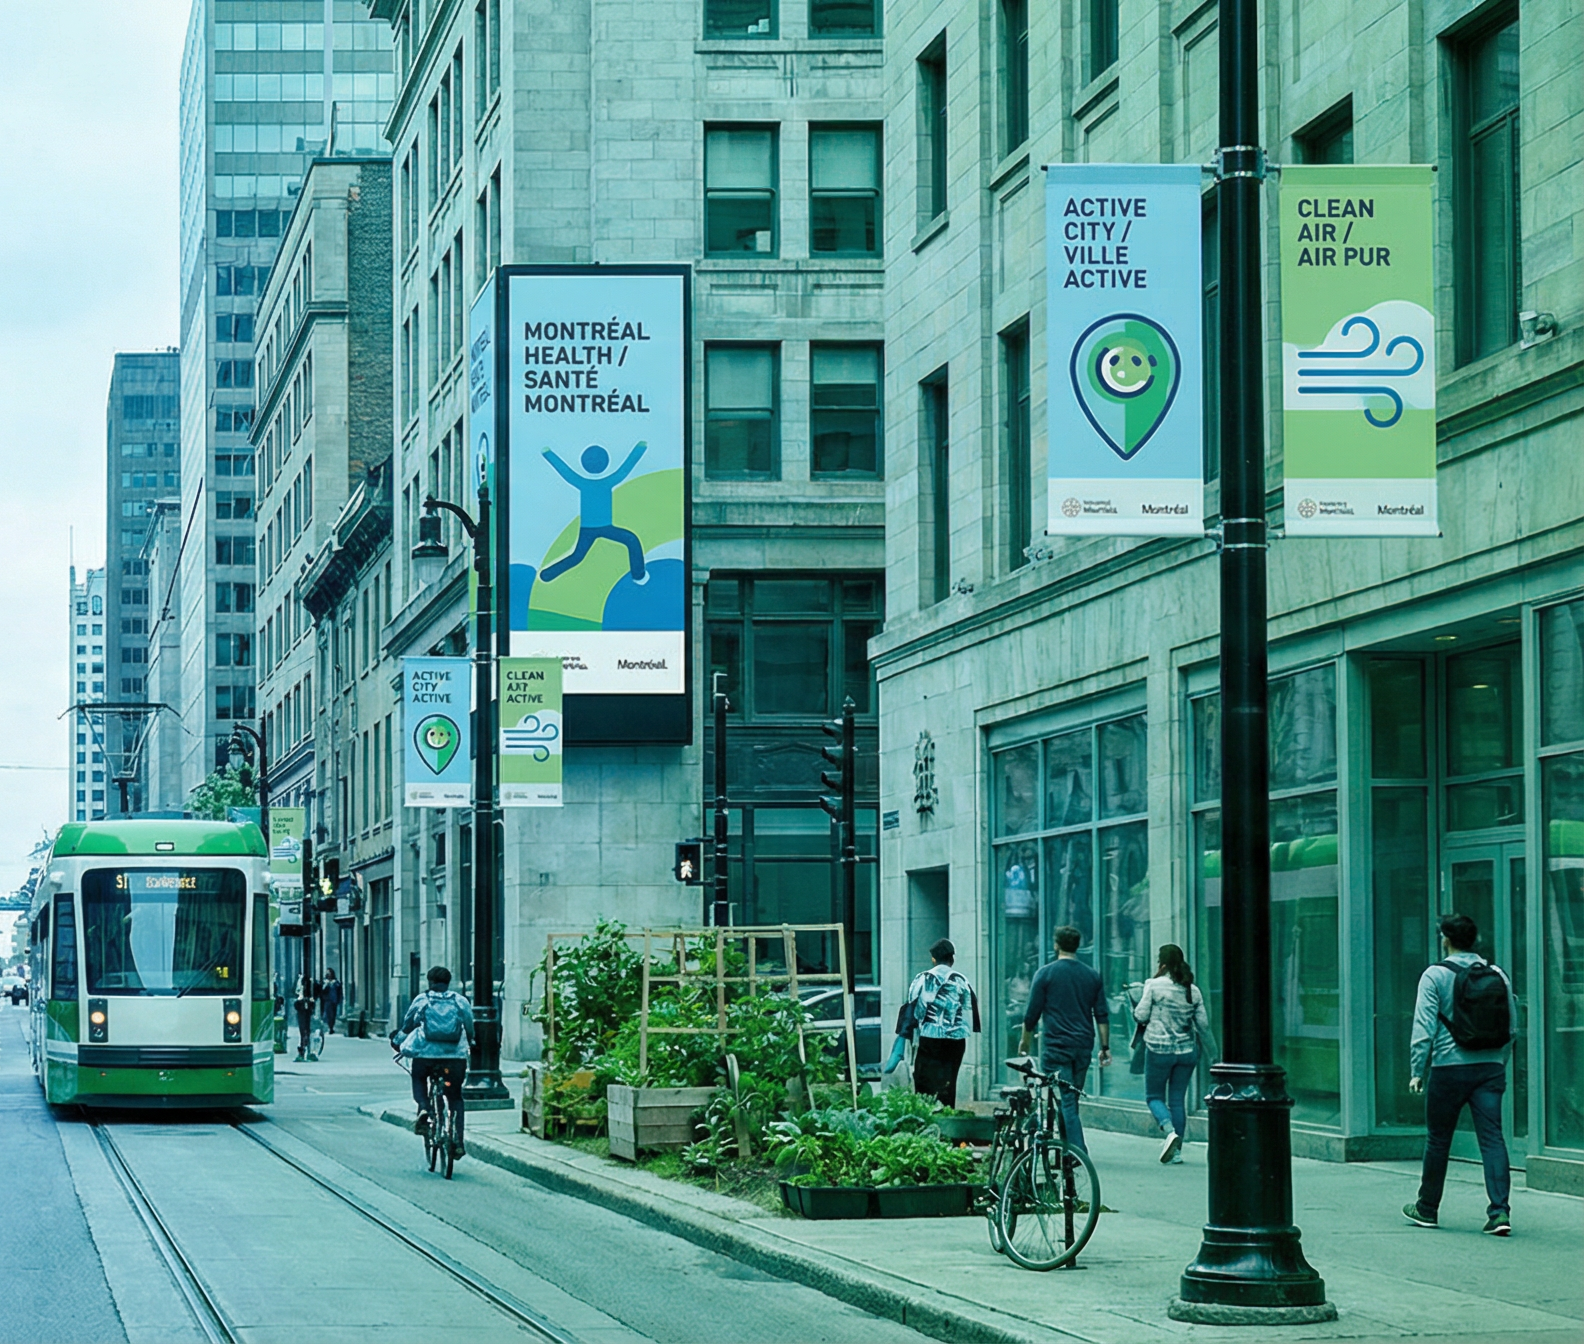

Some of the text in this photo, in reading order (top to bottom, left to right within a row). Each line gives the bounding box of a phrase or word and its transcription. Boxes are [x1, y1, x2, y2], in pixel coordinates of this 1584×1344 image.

[1063, 197, 1147, 218] ACTIVE
[1297, 198, 1374, 219] CLEAN
[1064, 219, 1133, 244] CITY /
[1297, 220, 1354, 244] AIR /
[1063, 245, 1129, 265] VILLE
[1297, 246, 1391, 267] AIR PUR
[1063, 268, 1147, 289] ACTIVE
[524, 316, 651, 341] MONTRÉAL
[524, 344, 629, 367] HEALTH /
[524, 366, 599, 390] SANTÉ
[524, 388, 651, 414] MONTRÉAL
[411, 671, 452, 682] ACTIVE
[506, 671, 545, 681] CLEAN
[412, 693, 452, 704] ACTIVE
[506, 693, 544, 704] ACTIVE
